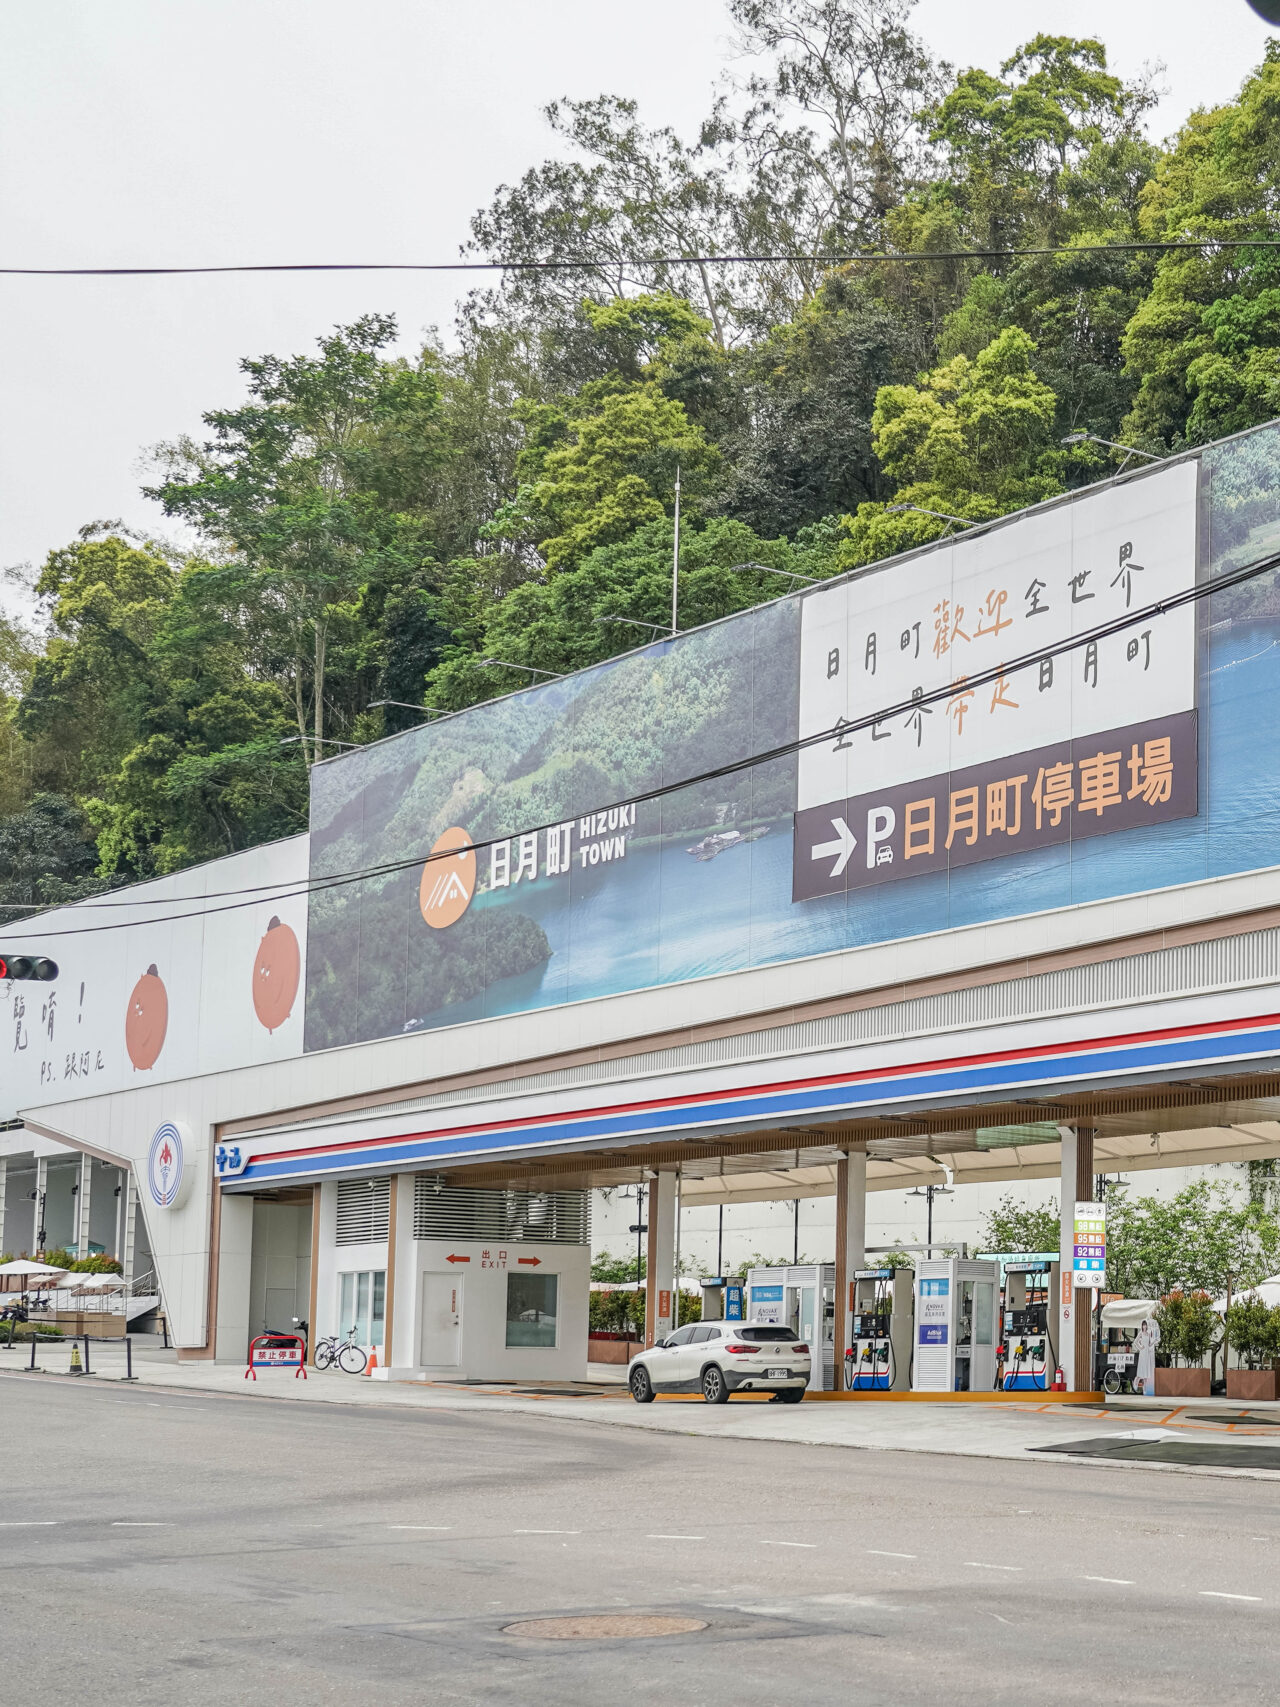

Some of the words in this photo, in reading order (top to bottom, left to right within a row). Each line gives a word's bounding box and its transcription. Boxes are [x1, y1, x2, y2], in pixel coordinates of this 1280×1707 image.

[826, 541, 1145, 680] 日月町歡迎全世界
[904, 737, 1174, 860] 日月町停車場
[579, 803, 637, 840] HIZUKI
[490, 821, 576, 890] 日月町
[580, 836, 626, 868] TOWN
[482, 1250, 507, 1260] 出口
[482, 1260, 507, 1269] EXIT
[729, 1289, 740, 1316] 超柴
[258, 1350, 297, 1360] 禁止停車
